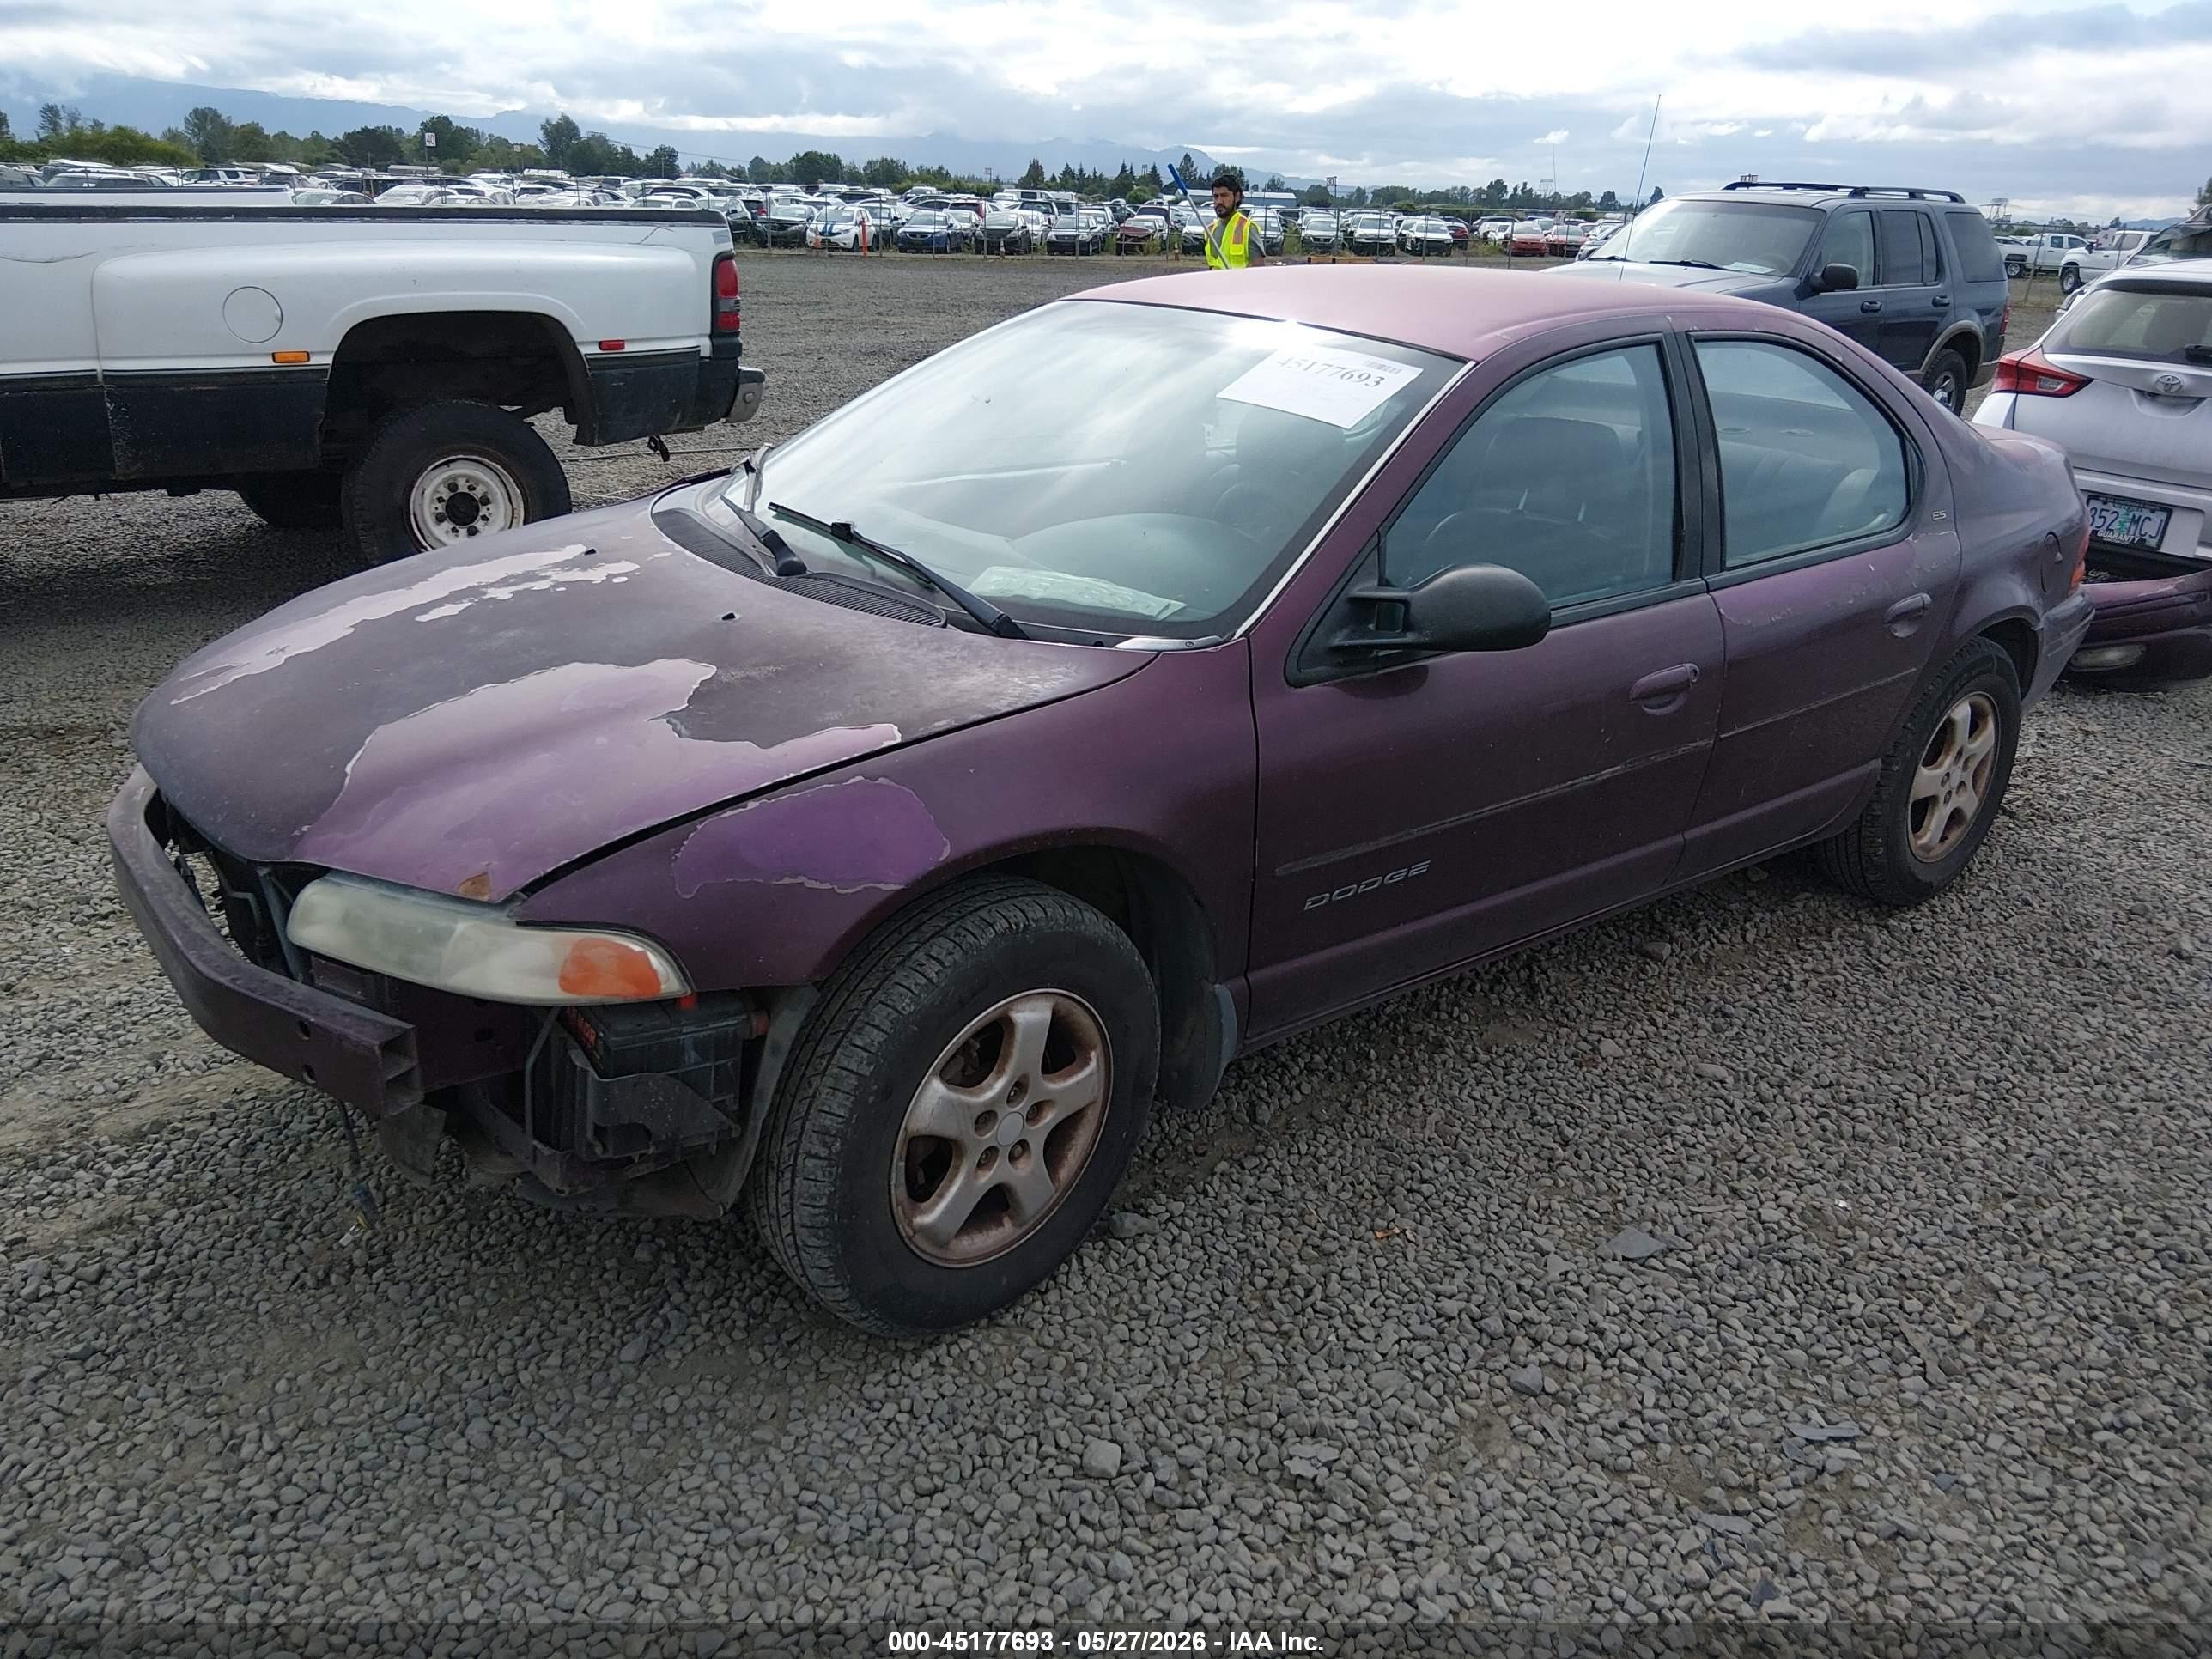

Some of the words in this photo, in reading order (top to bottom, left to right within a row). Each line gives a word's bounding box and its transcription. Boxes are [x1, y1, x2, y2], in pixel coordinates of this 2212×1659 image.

[426, 134, 435, 145] 40
[1277, 357, 1386, 387] 45177693
[1932, 510, 1947, 520] ES
[2097, 529, 2141, 544] GUARANTY
[2128, 514, 2163, 539] MCJ
[1304, 860, 1431, 911] DODGE
